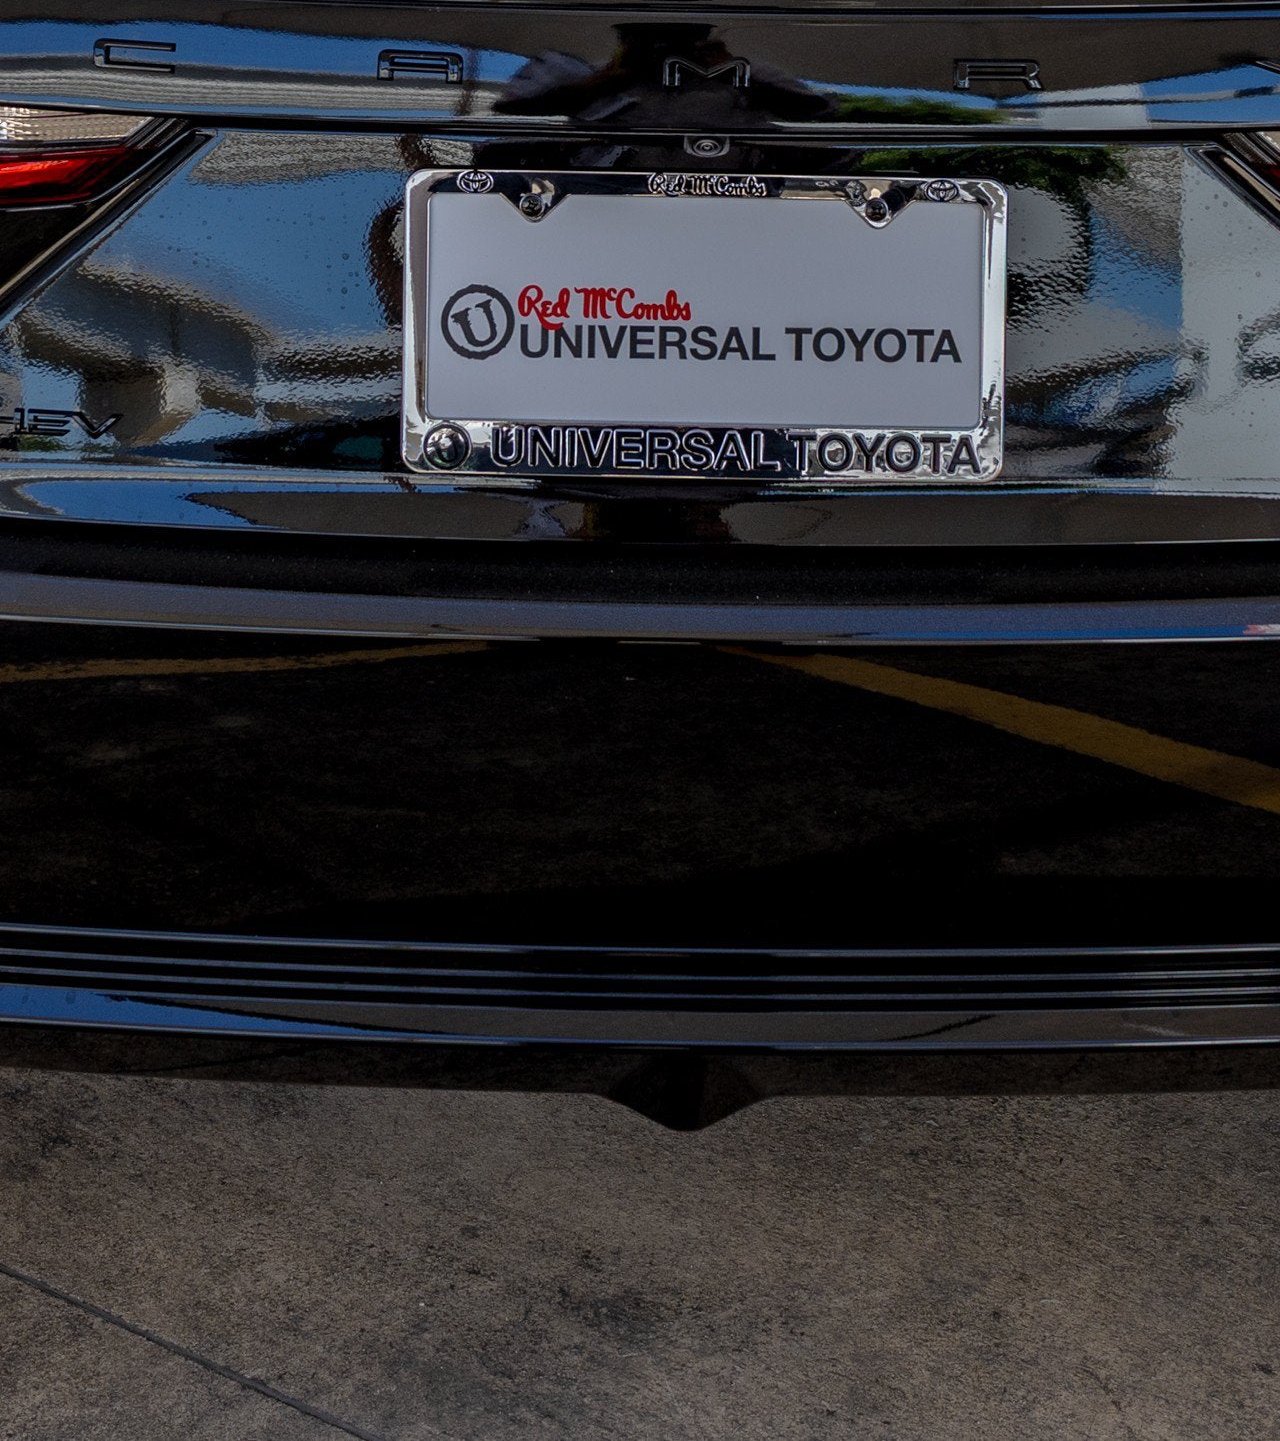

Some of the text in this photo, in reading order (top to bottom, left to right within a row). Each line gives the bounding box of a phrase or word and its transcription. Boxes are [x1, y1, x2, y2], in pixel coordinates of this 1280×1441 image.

[648, 172, 687, 197] Red
[517, 284, 691, 330] Red McCombs
[520, 323, 962, 364] UNIVERSAL TOYOTA
[491, 424, 984, 476] UNIVERSAL TOYOTA
